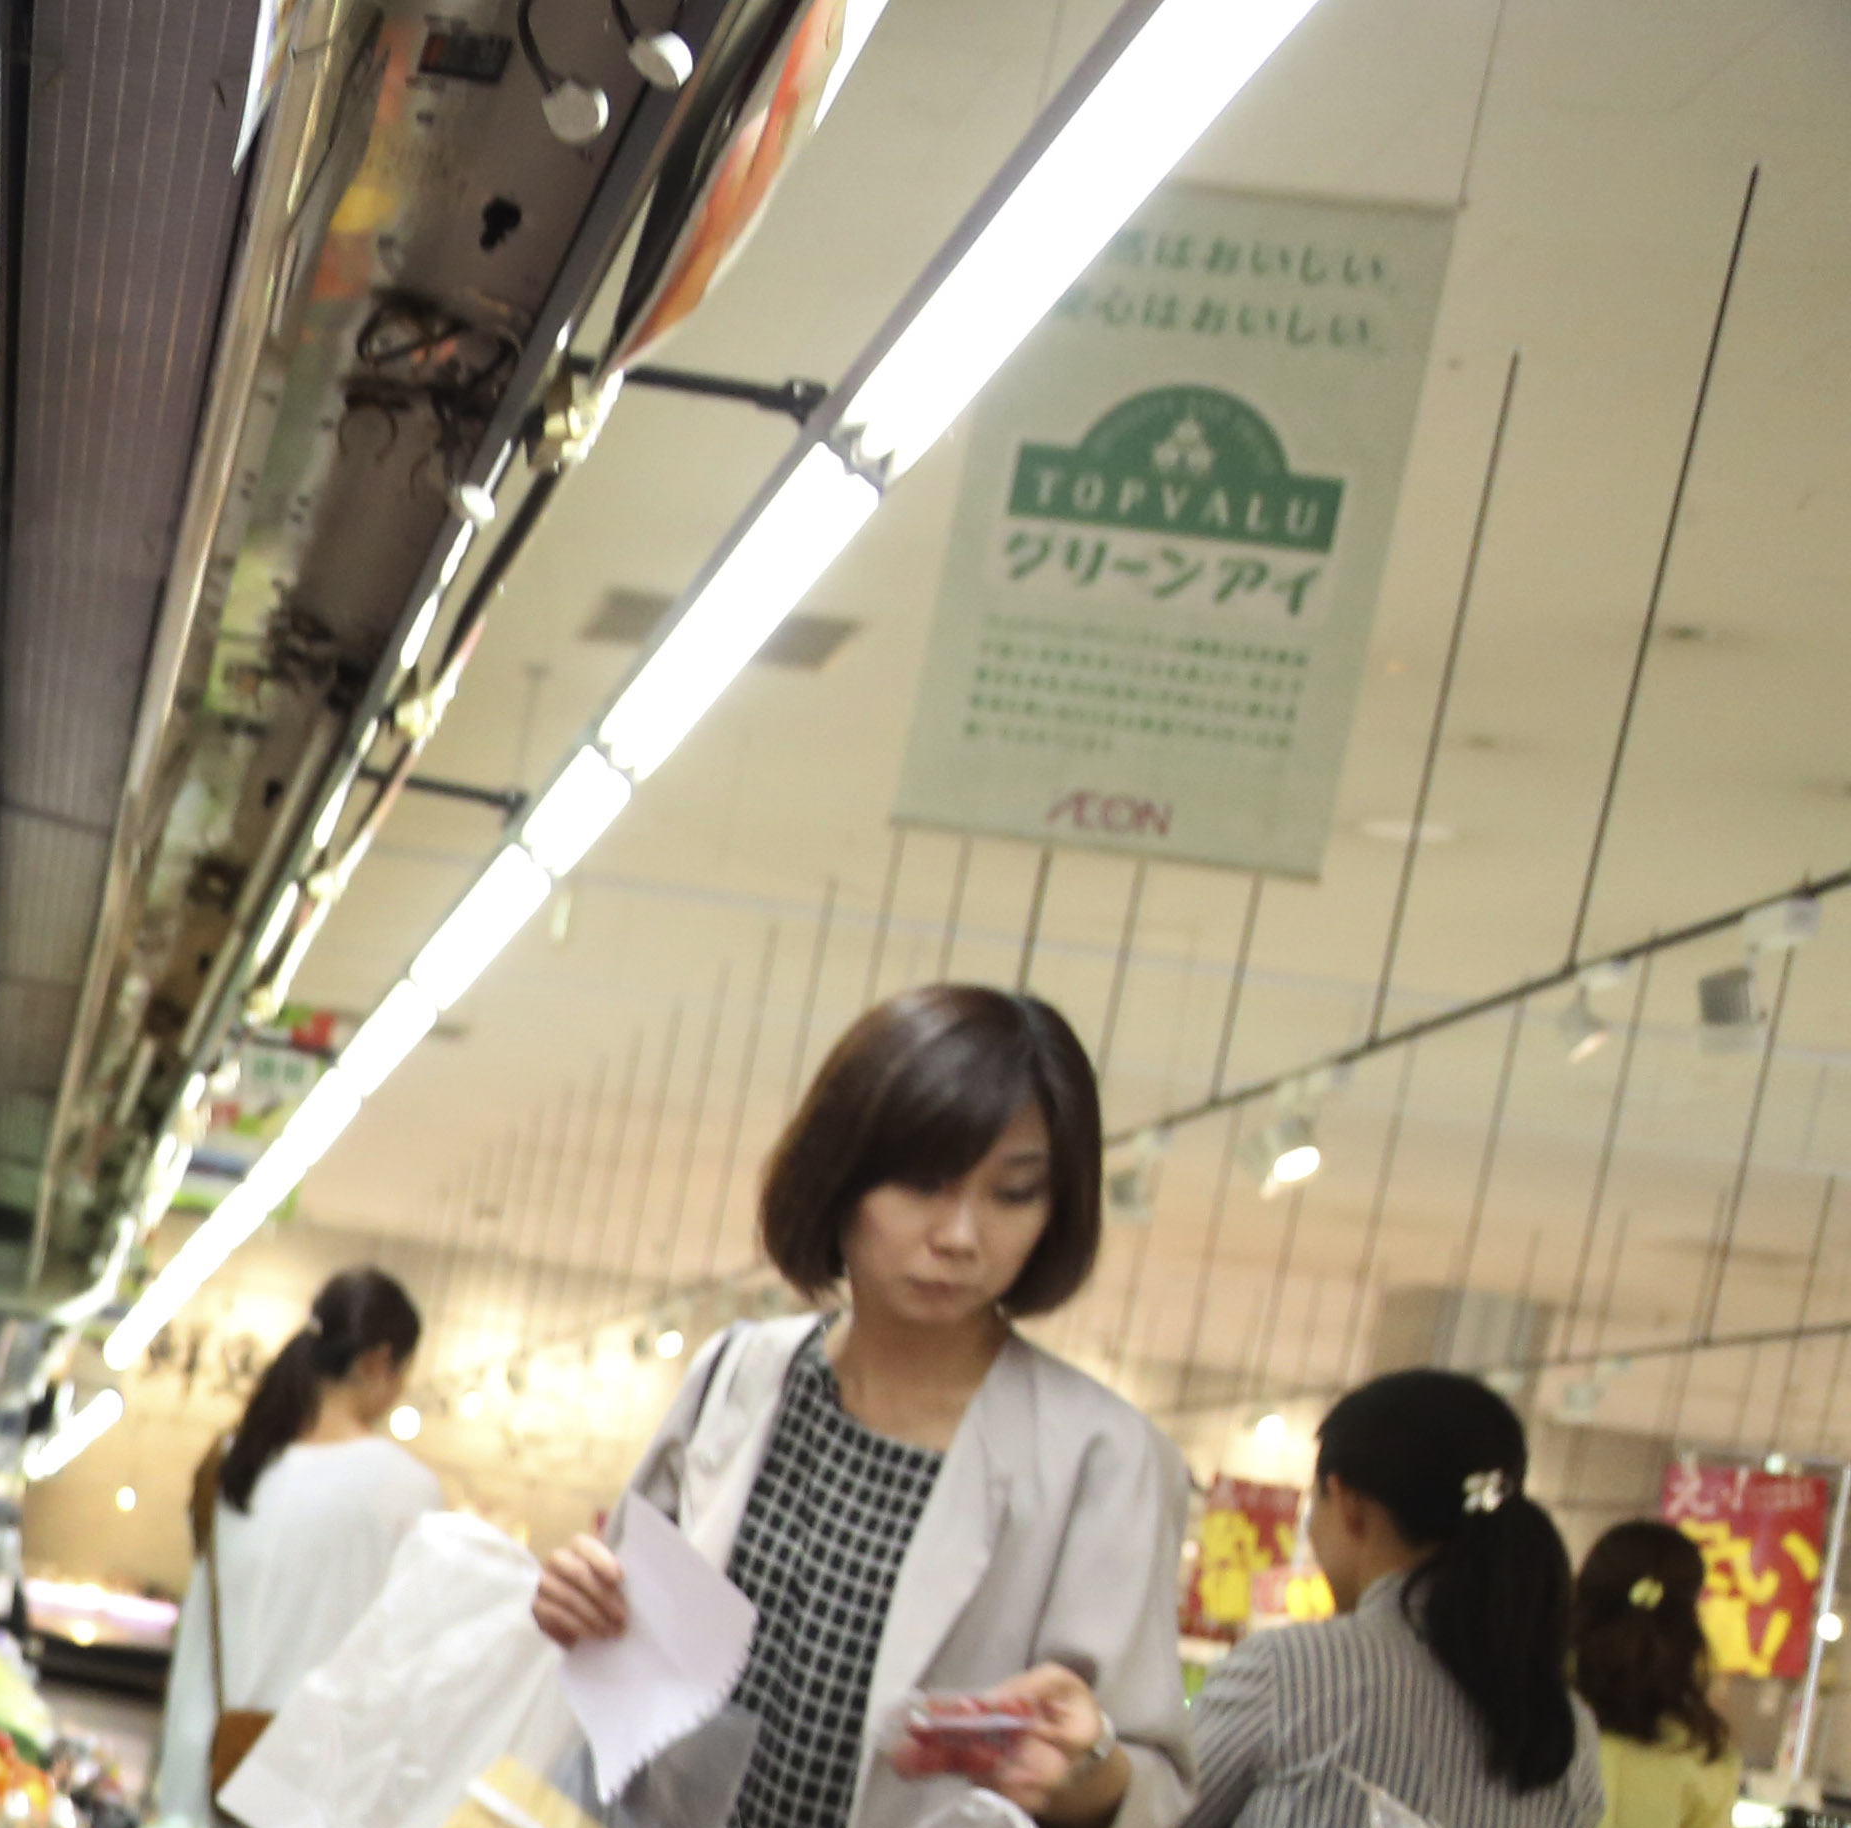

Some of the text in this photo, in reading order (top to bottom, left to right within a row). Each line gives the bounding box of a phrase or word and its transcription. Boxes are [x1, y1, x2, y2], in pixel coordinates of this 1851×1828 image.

[1033, 465, 1321, 540] TOPVALU
[1005, 530, 1321, 618] グリーンアイ
